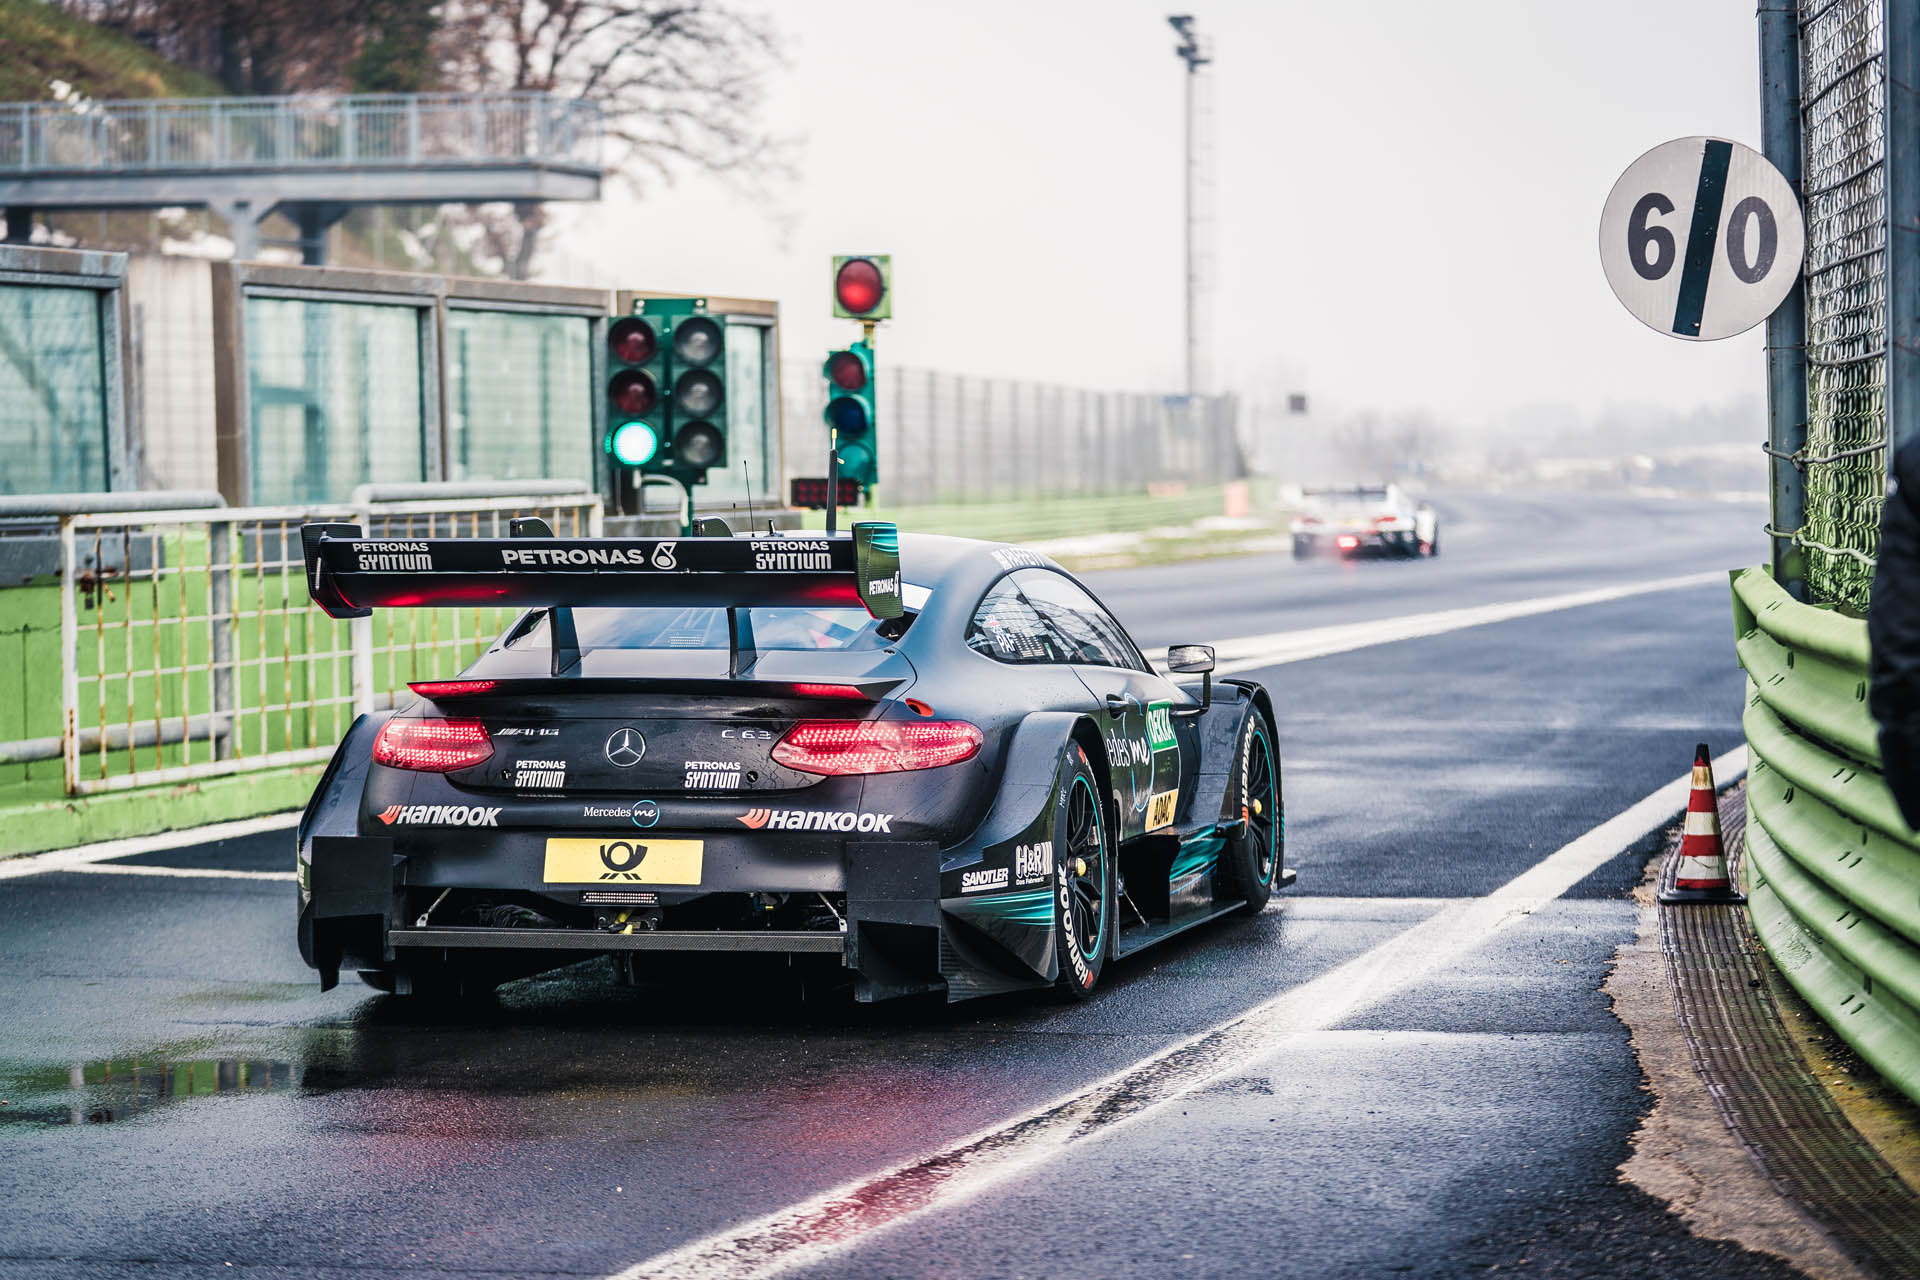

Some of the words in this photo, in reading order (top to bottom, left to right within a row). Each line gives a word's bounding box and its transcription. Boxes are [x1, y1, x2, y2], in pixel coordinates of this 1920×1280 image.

[352, 542, 429, 552] PETRONAS
[750, 541, 829, 551] PETRONAS
[358, 553, 432, 571] SYNTIUM
[501, 548, 645, 566] PETRONAS
[755, 552, 832, 570] SYNTIUM
[869, 578, 894, 596] PETRONAS
[721, 729, 735, 739] C
[1147, 706, 1176, 744] DEKRA
[1129, 737, 1150, 765] me
[515, 760, 566, 770] PETRONAS
[684, 761, 741, 771] PETRONAS
[515, 770, 566, 789] SYNTIUM
[684, 771, 741, 790] SYNTIUM
[583, 806, 632, 817] Mercedes
[634, 809, 657, 817] me
[1152, 794, 1172, 827] ADAC
[962, 867, 1009, 887] SANDTLER
